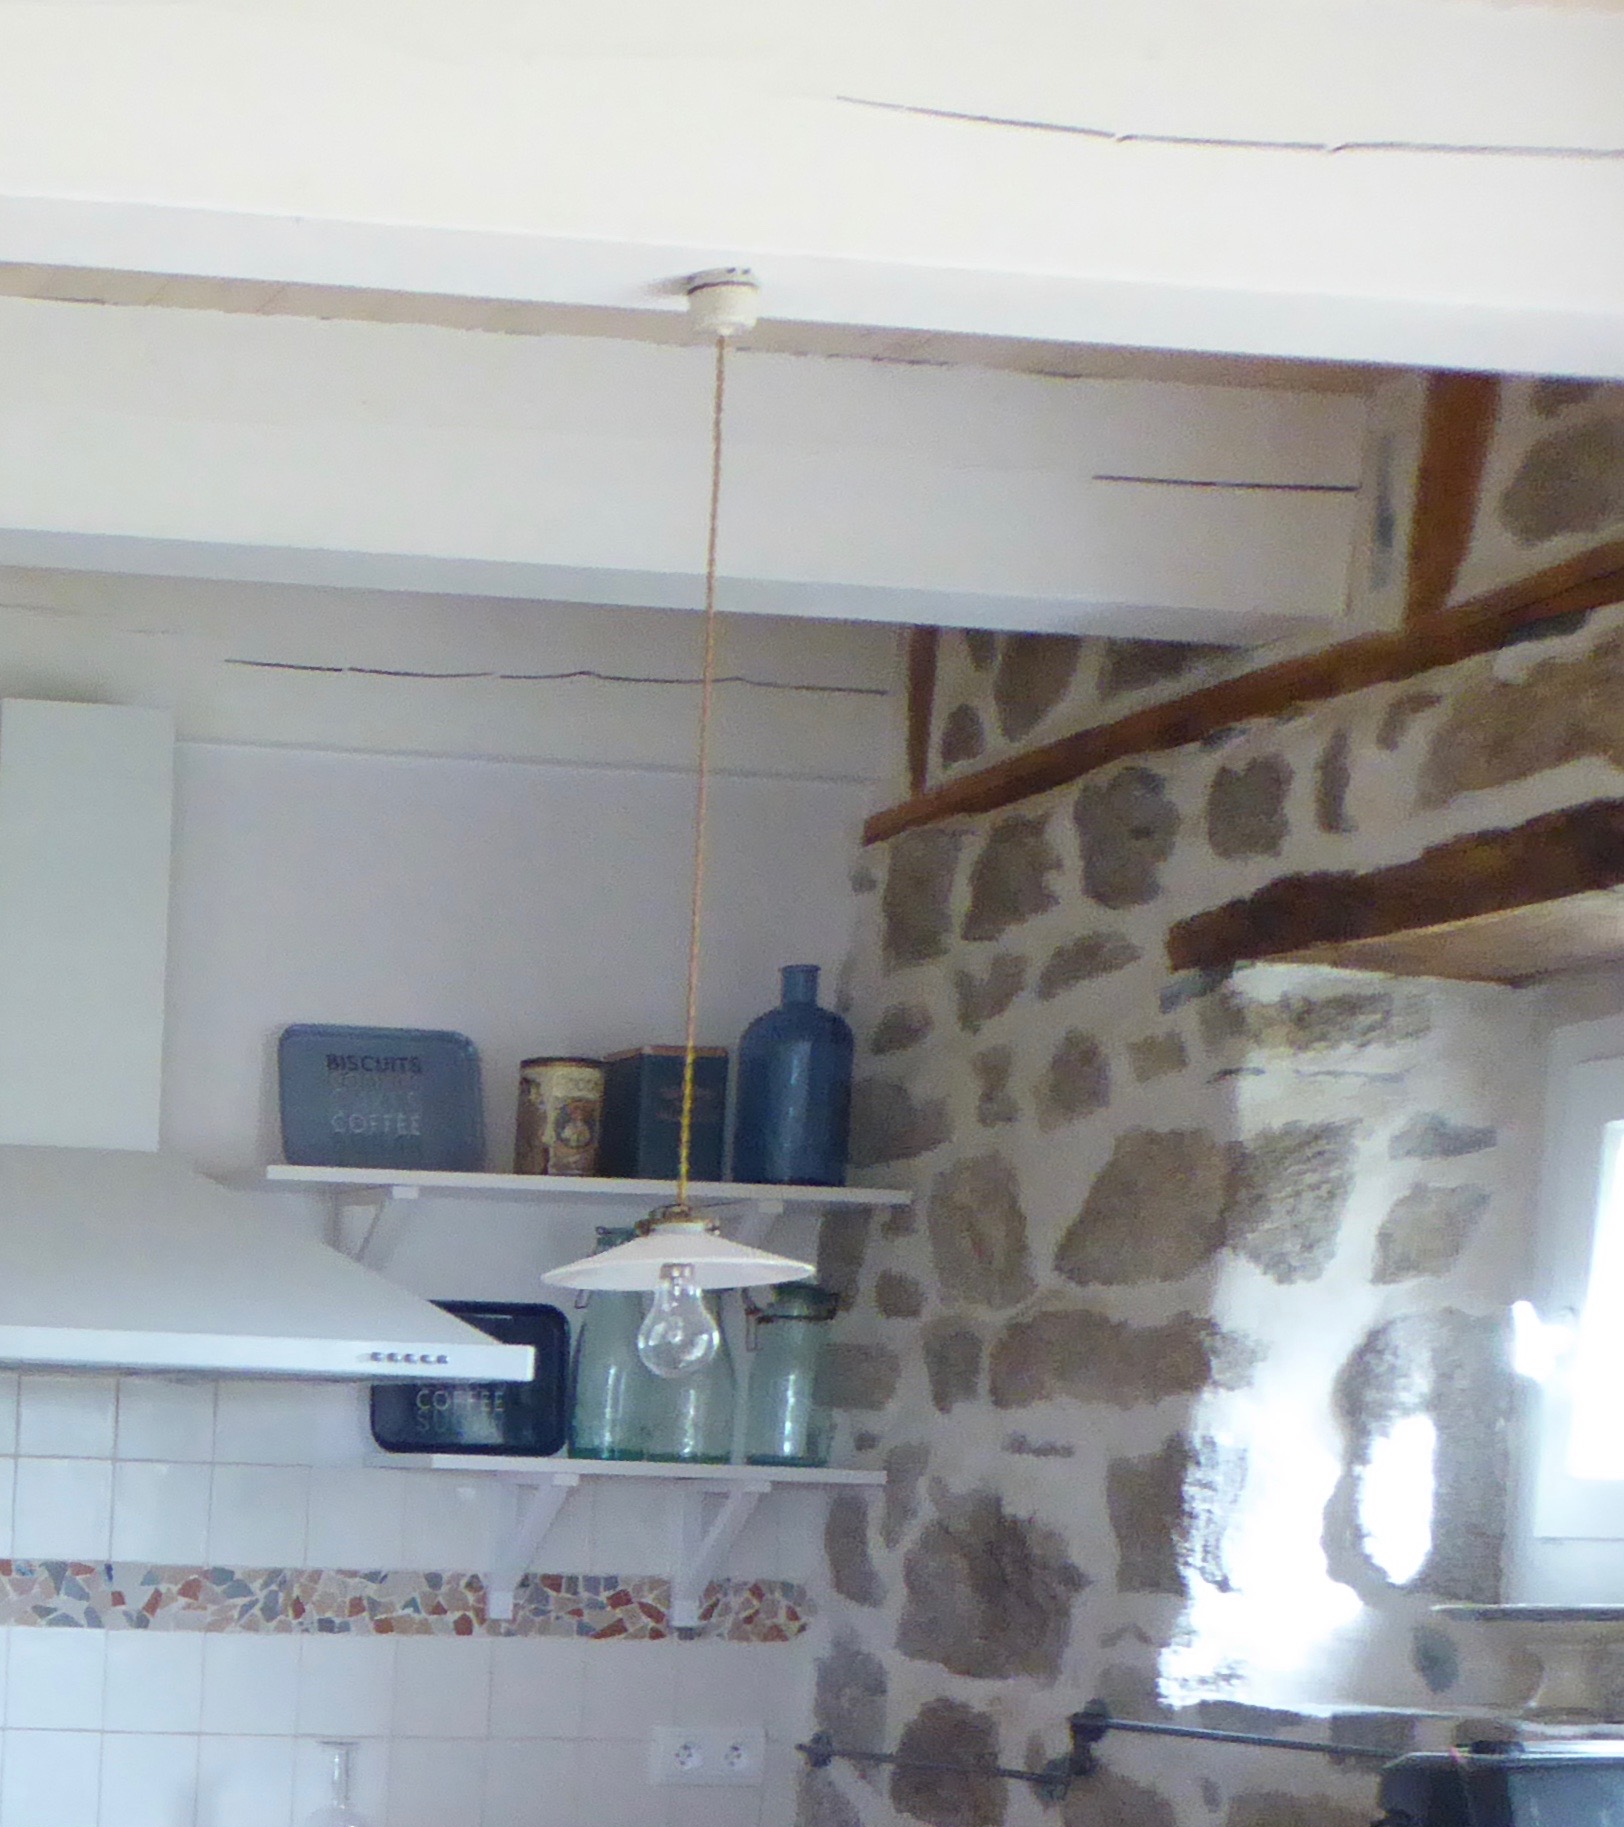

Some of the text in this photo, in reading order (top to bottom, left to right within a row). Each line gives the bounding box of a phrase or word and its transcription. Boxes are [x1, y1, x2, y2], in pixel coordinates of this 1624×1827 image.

[325, 1054, 423, 1073] BISCUITS
[330, 1113, 422, 1136] COFFEE
[416, 1390, 505, 1411] COFFEE
